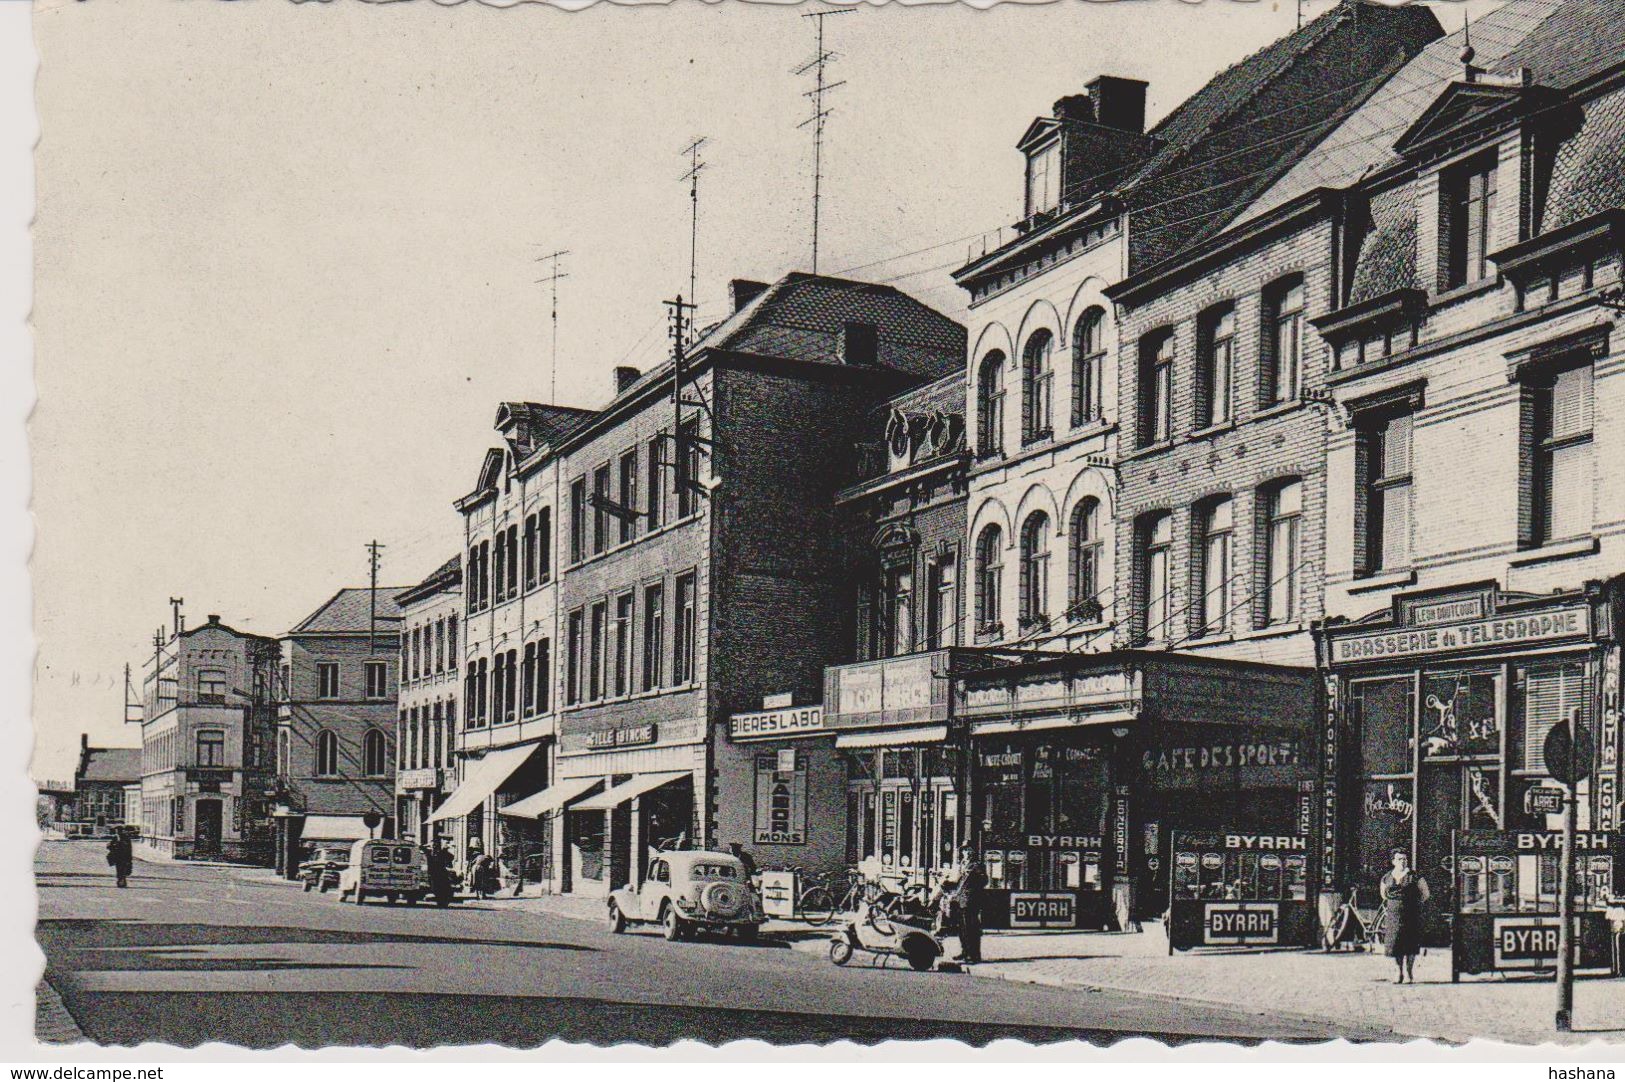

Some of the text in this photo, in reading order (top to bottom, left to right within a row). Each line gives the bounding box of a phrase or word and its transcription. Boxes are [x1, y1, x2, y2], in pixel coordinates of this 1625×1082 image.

[1341, 612, 1577, 658] BRASSERIE du TELEGRAPHE
[731, 710, 820, 733] BIERES LABO
[772, 772, 790, 833] LABOR
[1534, 795, 1560, 808] ARRET
[759, 833, 801, 842] MONS
[1028, 835, 1102, 847] BYRRH
[1226, 835, 1306, 849] BYRRH
[1017, 902, 1068, 917] BYRRH
[1213, 914, 1269, 931] BYRRH
[1503, 930, 1557, 952] BYRR
